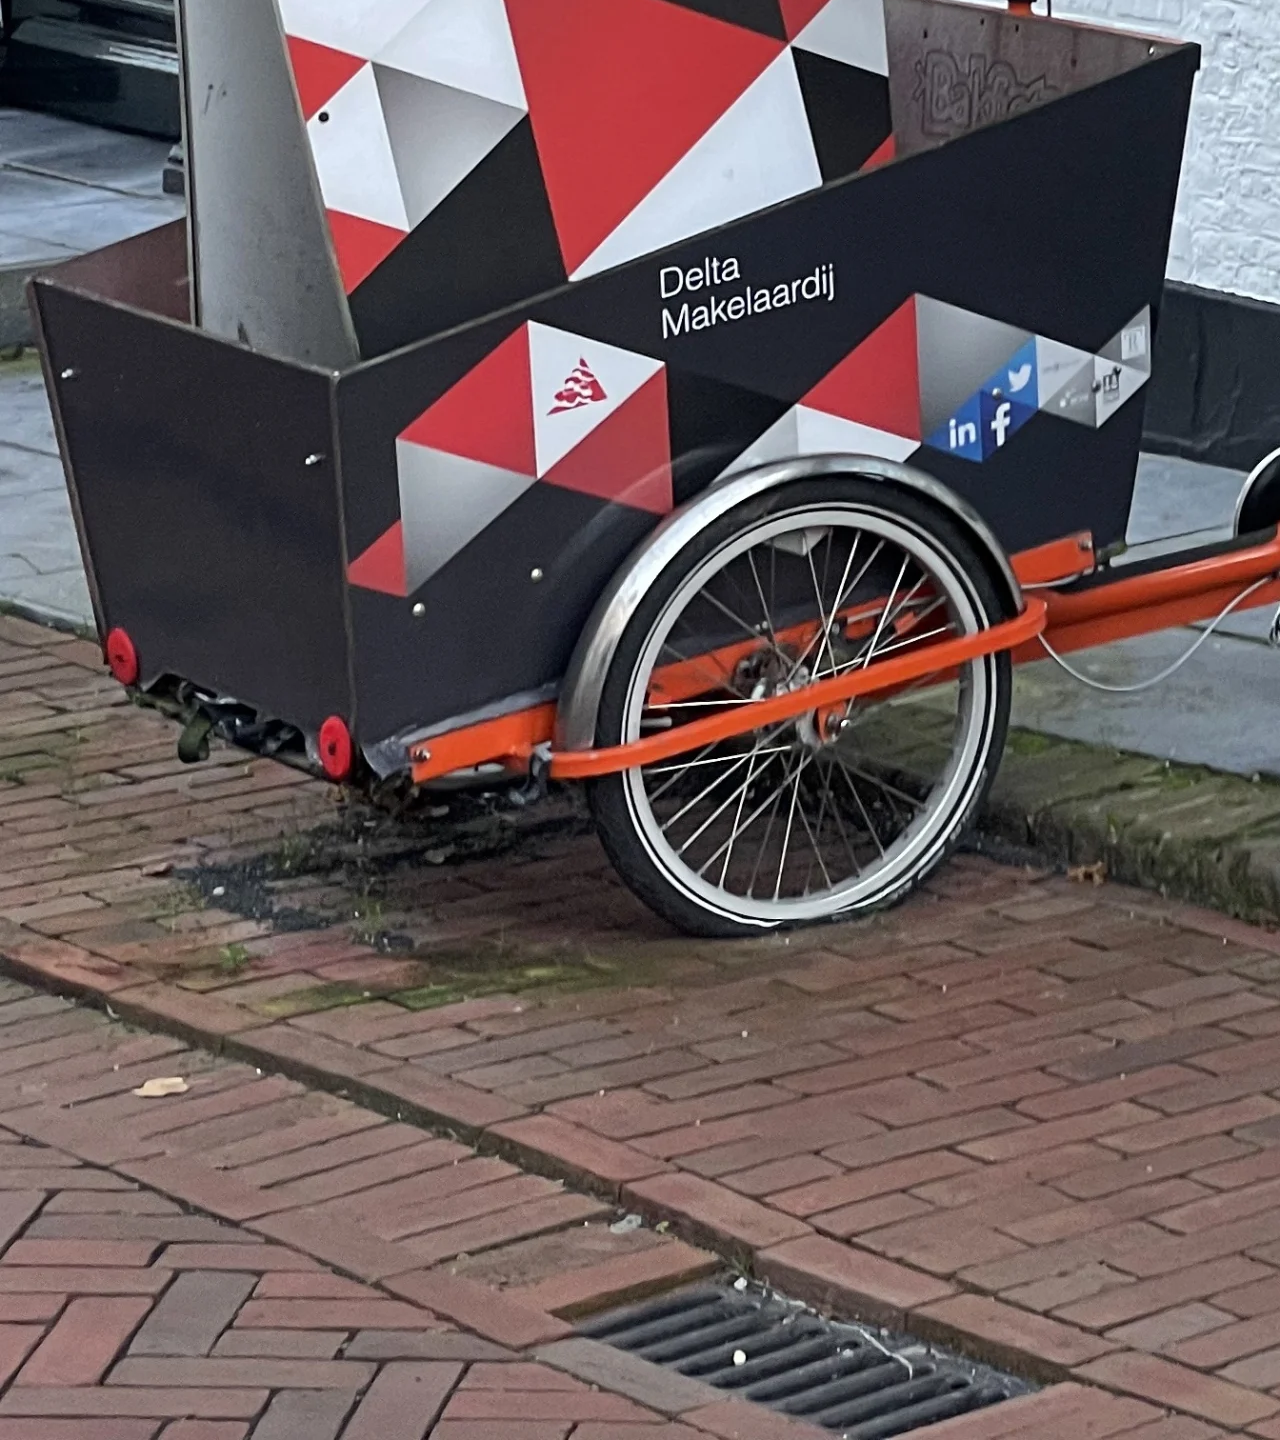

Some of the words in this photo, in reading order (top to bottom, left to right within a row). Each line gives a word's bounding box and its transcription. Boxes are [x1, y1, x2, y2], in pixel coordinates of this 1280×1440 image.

[660, 257, 741, 299] Delta
[662, 263, 835, 339] Makelaardij
[949, 418, 976, 449] in
[991, 402, 1011, 447] f
